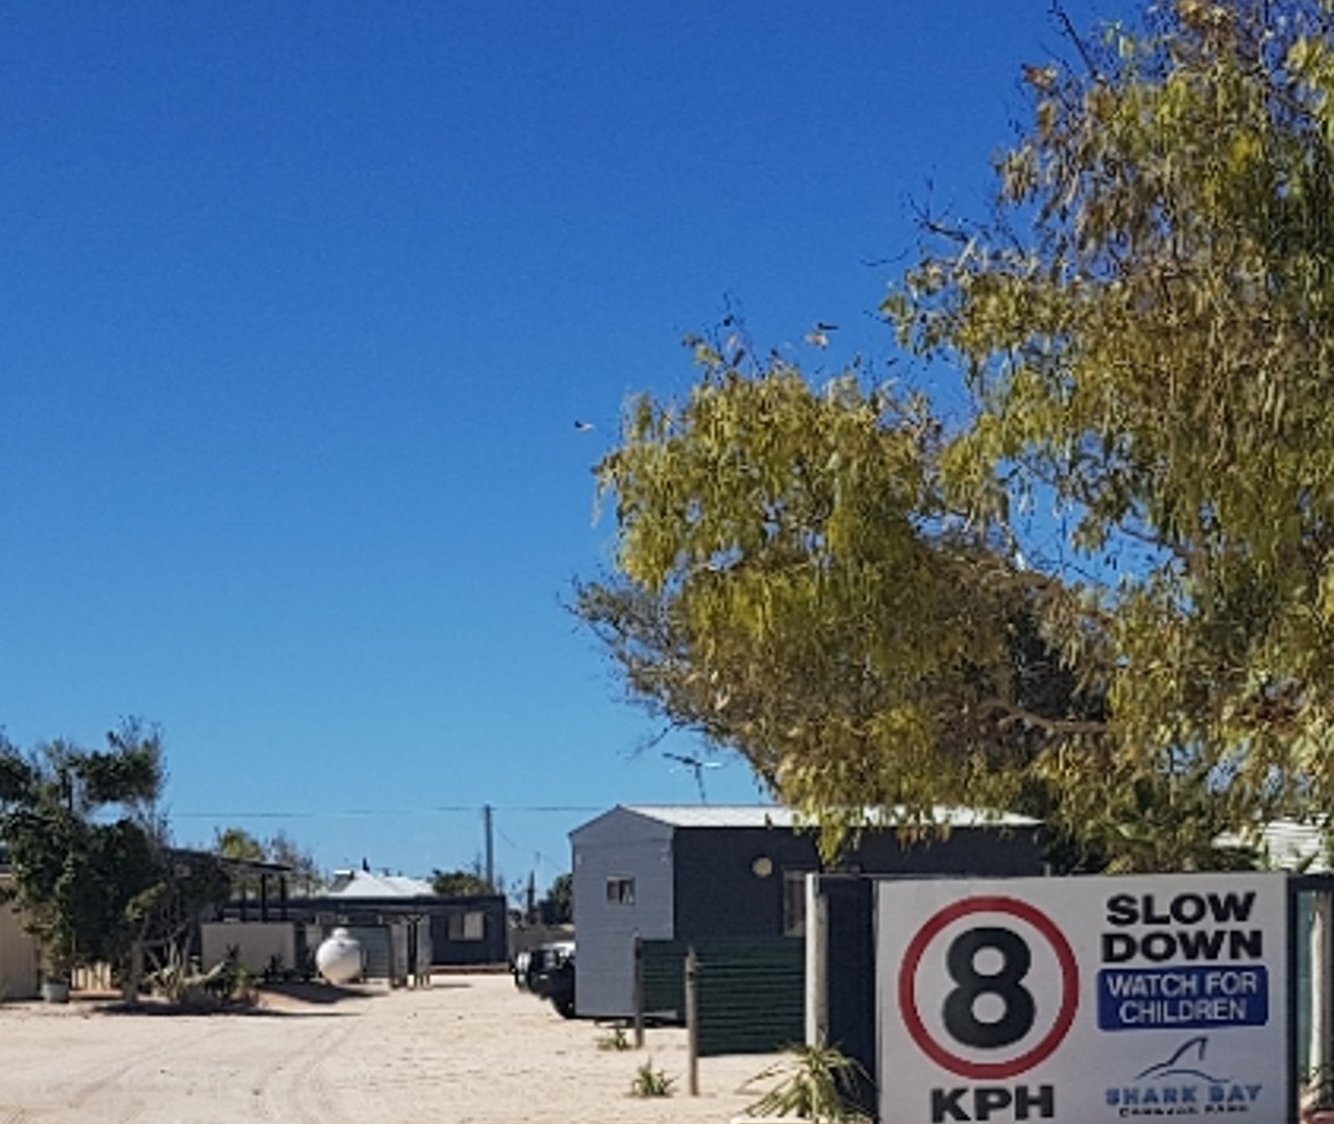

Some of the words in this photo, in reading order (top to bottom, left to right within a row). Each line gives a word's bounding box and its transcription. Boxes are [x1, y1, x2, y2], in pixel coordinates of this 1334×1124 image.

[1106, 892, 1256, 926] SLOW
[1102, 930, 1263, 963] DOWN
[942, 927, 1036, 1050] 8
[1106, 974, 1197, 997] WATCH
[1206, 971, 1257, 995] FOR
[1119, 999, 1247, 1024] CHILDREN
[930, 1084, 1055, 1124] KPH
[1106, 1087, 1197, 1106] SHARK
[1209, 1084, 1262, 1103] BAY
